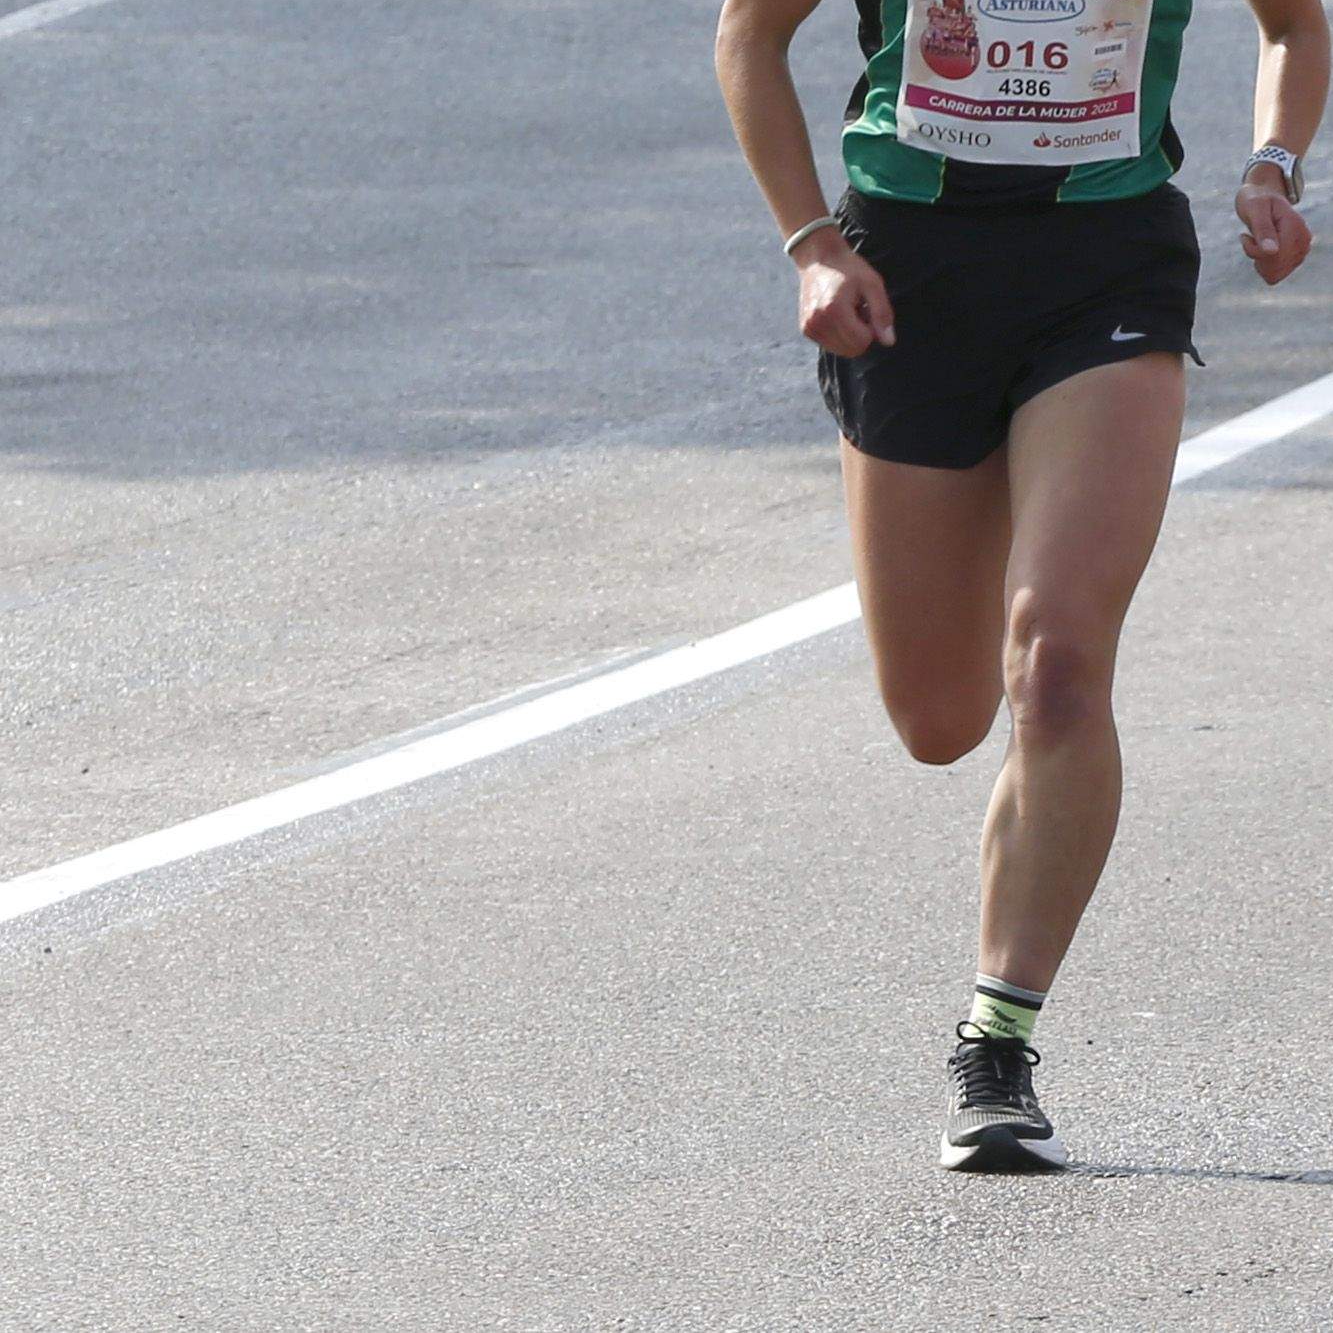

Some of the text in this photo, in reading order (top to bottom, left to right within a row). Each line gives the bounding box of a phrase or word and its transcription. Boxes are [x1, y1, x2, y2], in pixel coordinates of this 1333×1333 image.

[986, 40, 1069, 70] 016
[998, 78, 1051, 97] 4386
[928, 95, 1118, 118] CARRERA DE LA MUJER 2023
[918, 122, 992, 148] OYSHO
[1053, 129, 1122, 149] Santander
